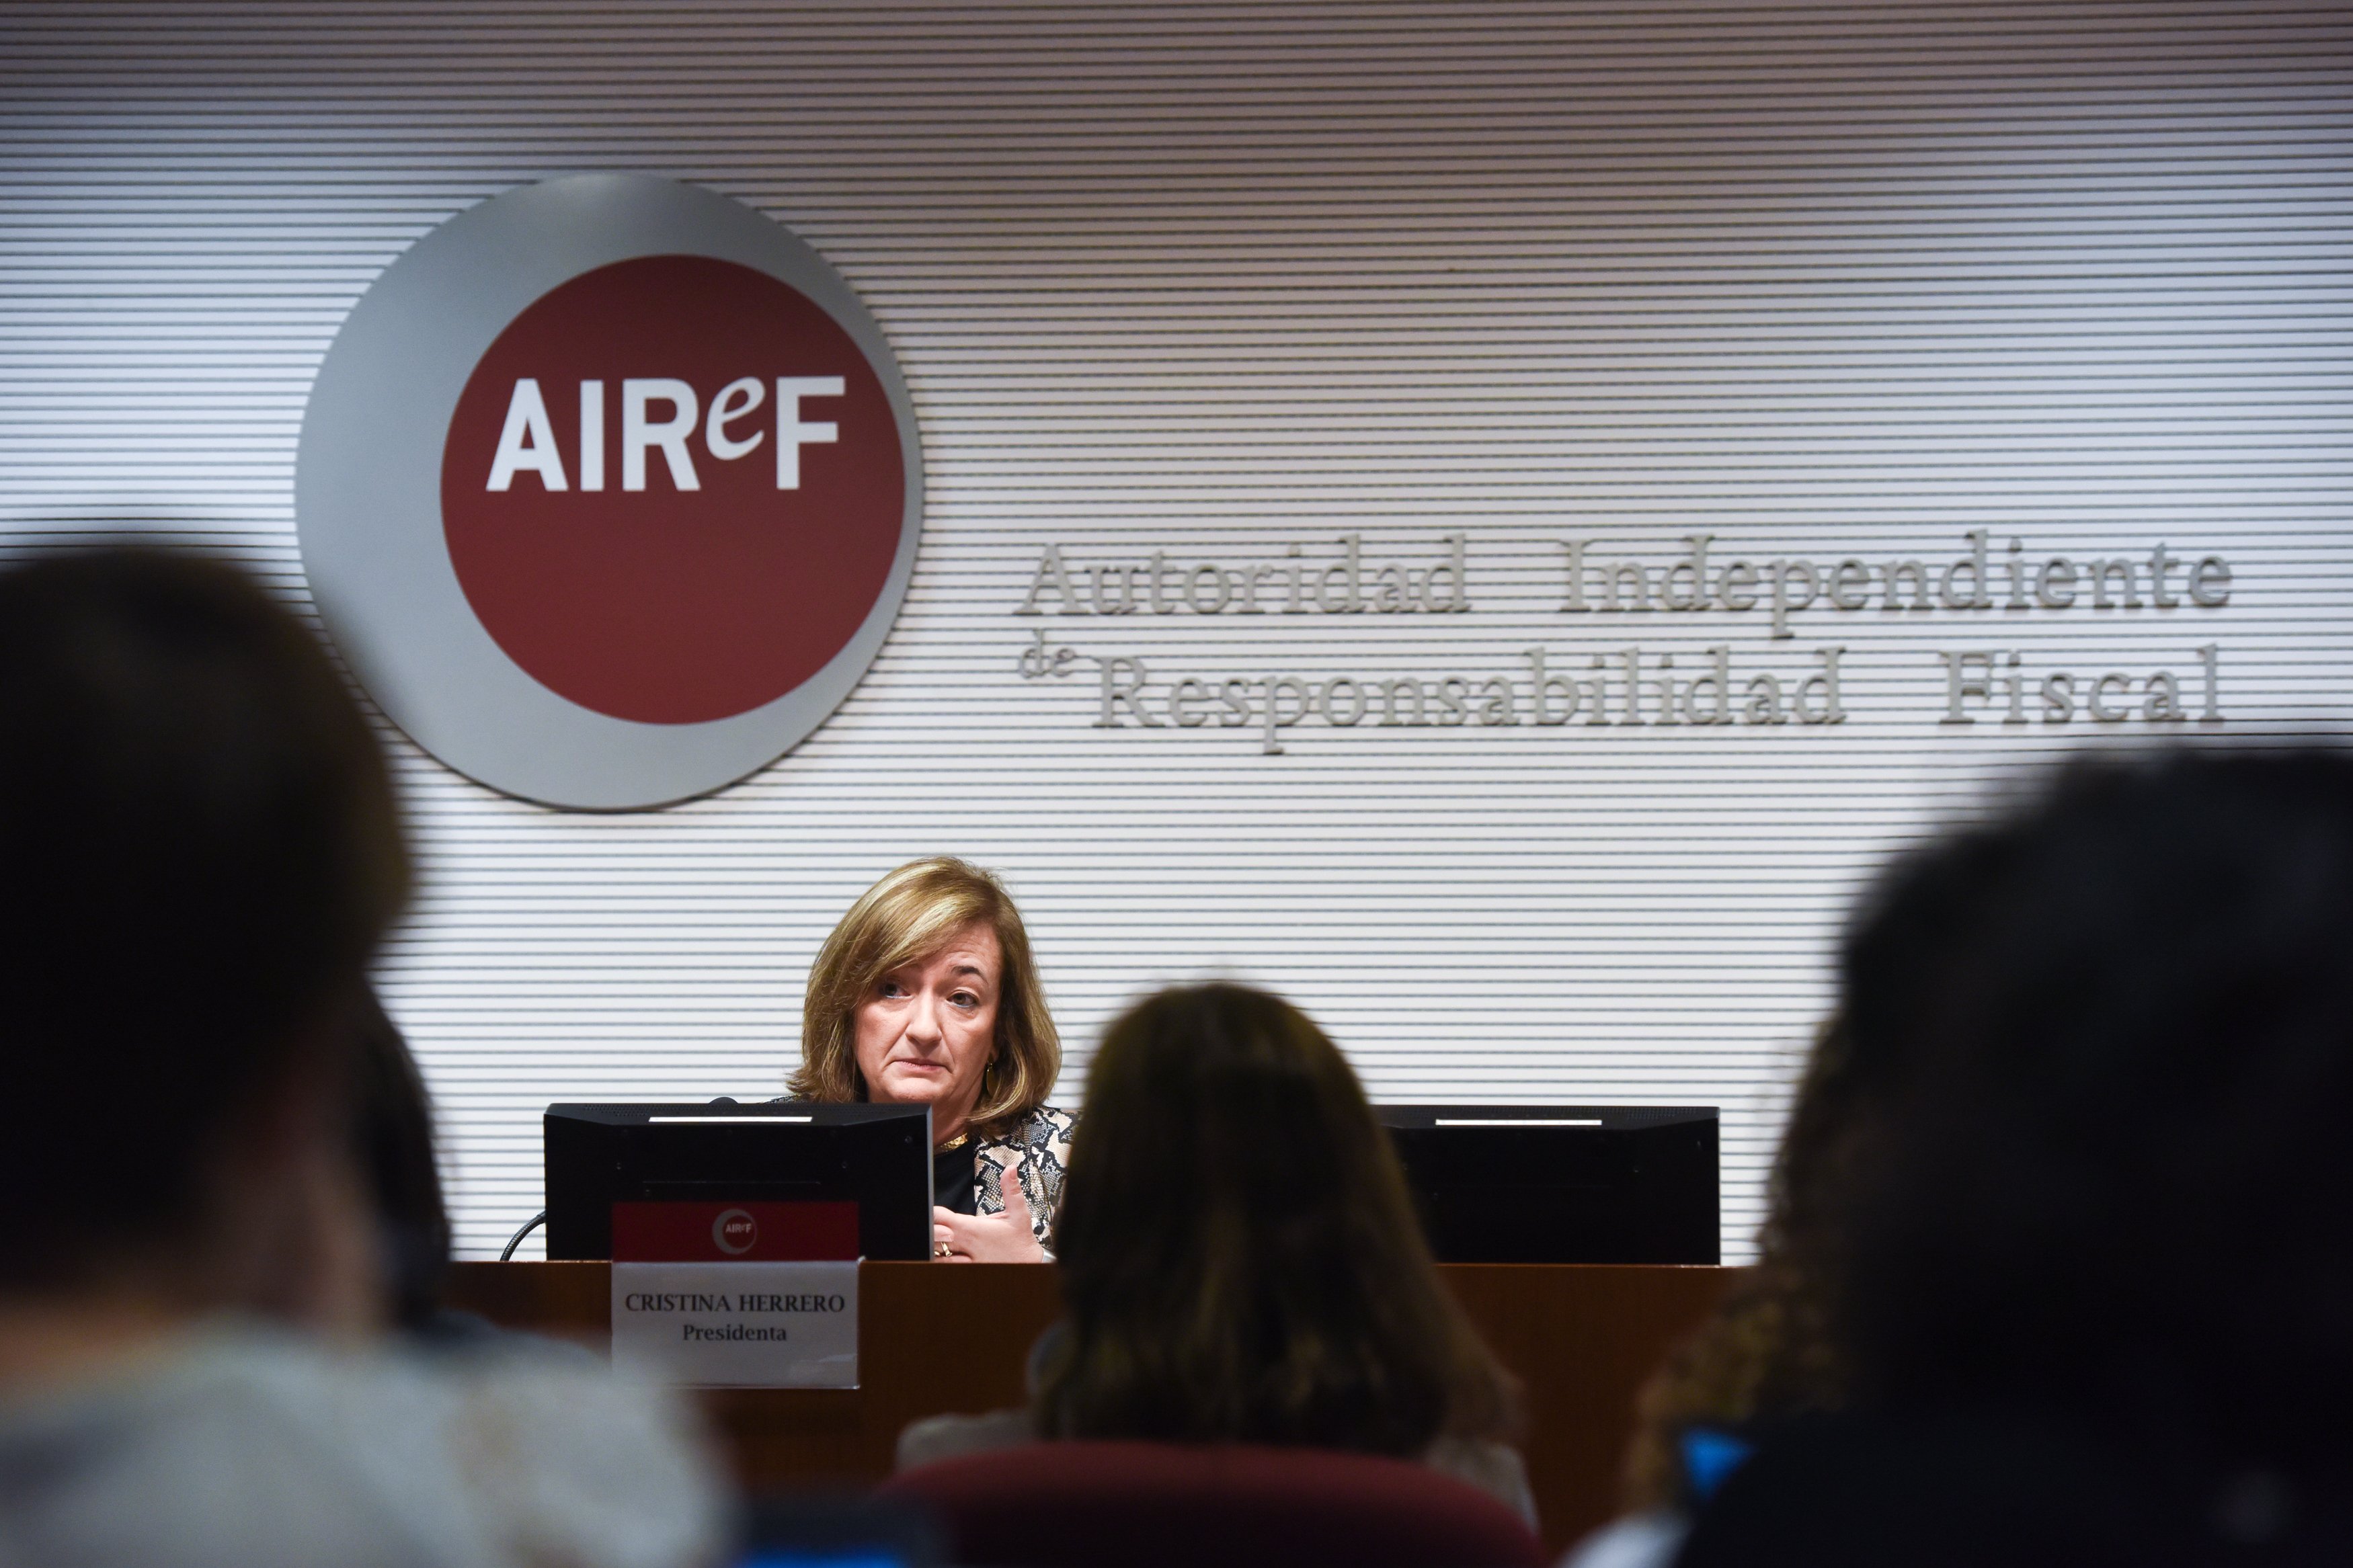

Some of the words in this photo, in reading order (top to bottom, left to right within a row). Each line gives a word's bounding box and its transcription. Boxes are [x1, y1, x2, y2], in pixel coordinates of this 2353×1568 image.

[485, 376, 846, 491] AIReF
[1012, 533, 1472, 614] Autoridad
[1556, 528, 2232, 639] Independiente
[1017, 628, 1077, 679] de
[1091, 645, 1847, 755] Responsabilidad
[1939, 642, 2225, 725] Fiscal
[625, 1293, 731, 1313] CRISTINA
[739, 1294, 846, 1313] HERRERO
[682, 1324, 787, 1342] Presidenta
